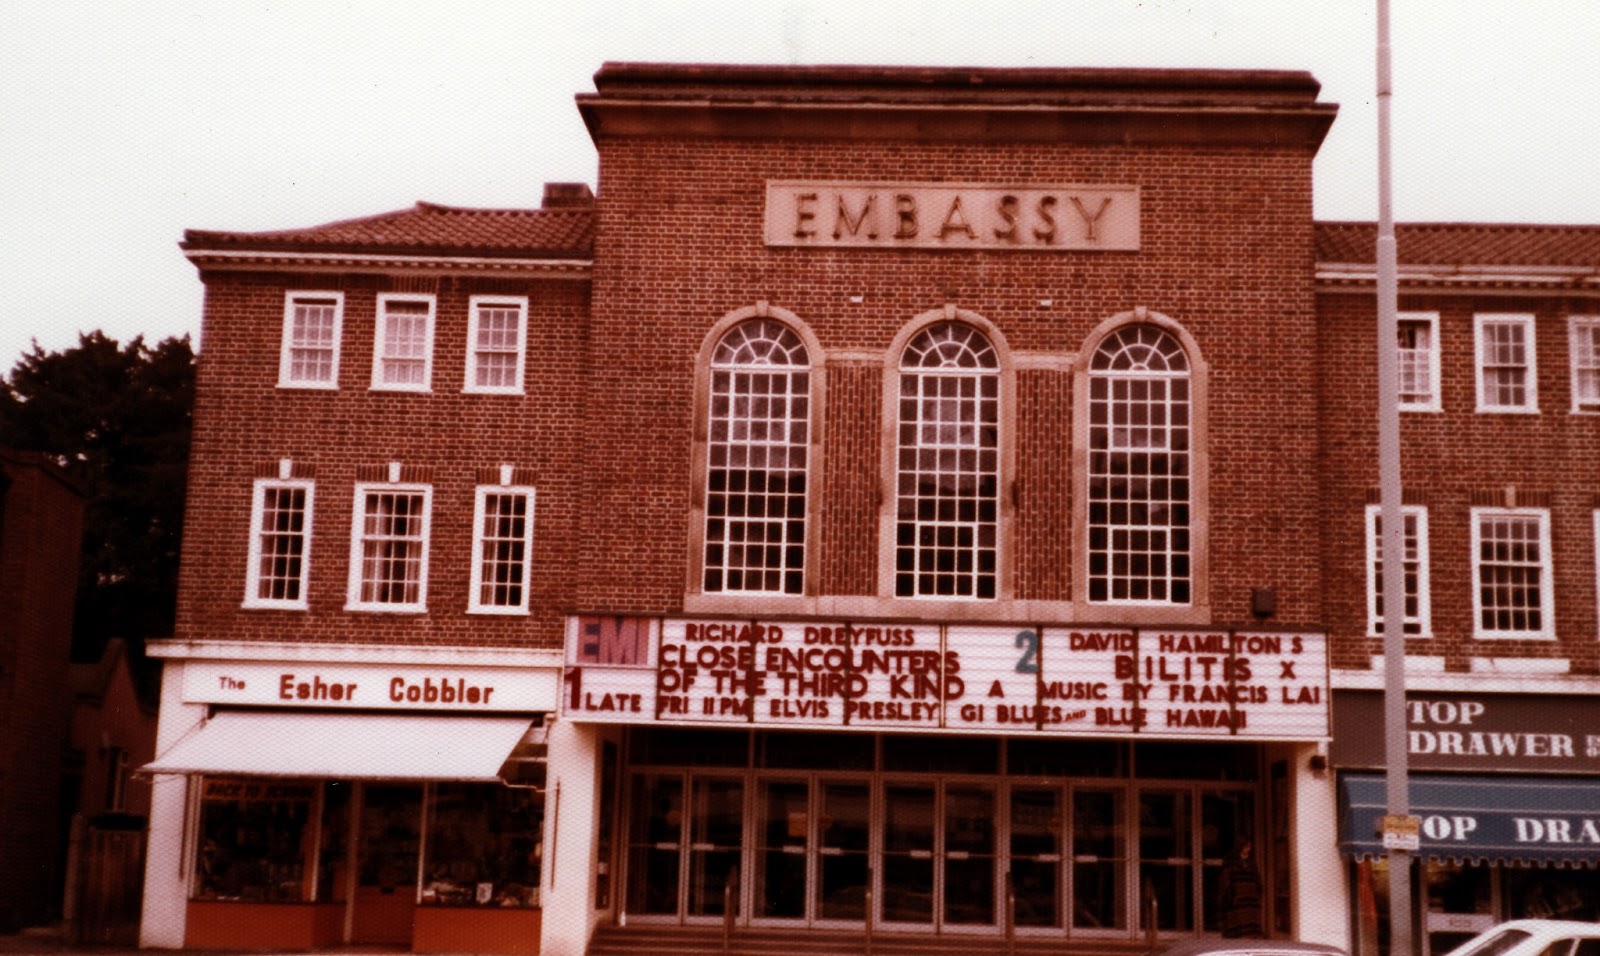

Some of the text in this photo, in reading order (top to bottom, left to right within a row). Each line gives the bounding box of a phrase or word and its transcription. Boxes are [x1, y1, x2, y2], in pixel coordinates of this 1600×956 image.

[793, 192, 1112, 246] EMBASSY
[577, 615, 648, 665] EMI
[686, 623, 914, 646] RICHARD DREYFUSS
[1069, 633, 1133, 652] DAVID
[1159, 635, 1281, 653] HAMILTON
[659, 644, 960, 675] CLOSE ENCOUNTERS
[1015, 631, 1039, 674] 2
[1115, 656, 1296, 682] BILITIS X
[219, 674, 494, 704] The Esher Cobbler
[564, 667, 582, 710] 1
[659, 669, 1005, 700] OF THE THIRD KIND A
[1038, 681, 1321, 704] MUSIC BY FRANCIS LAI
[585, 692, 642, 712] LATE
[658, 696, 689, 715] FRI
[769, 699, 829, 718] ELVIS
[847, 701, 939, 720] PRESLEY
[960, 704, 984, 722] GI
[996, 705, 1062, 724] BLUES
[1095, 707, 1148, 727] BLUE
[1407, 700, 1485, 724] TOP
[1409, 730, 1576, 758] DRAWER
